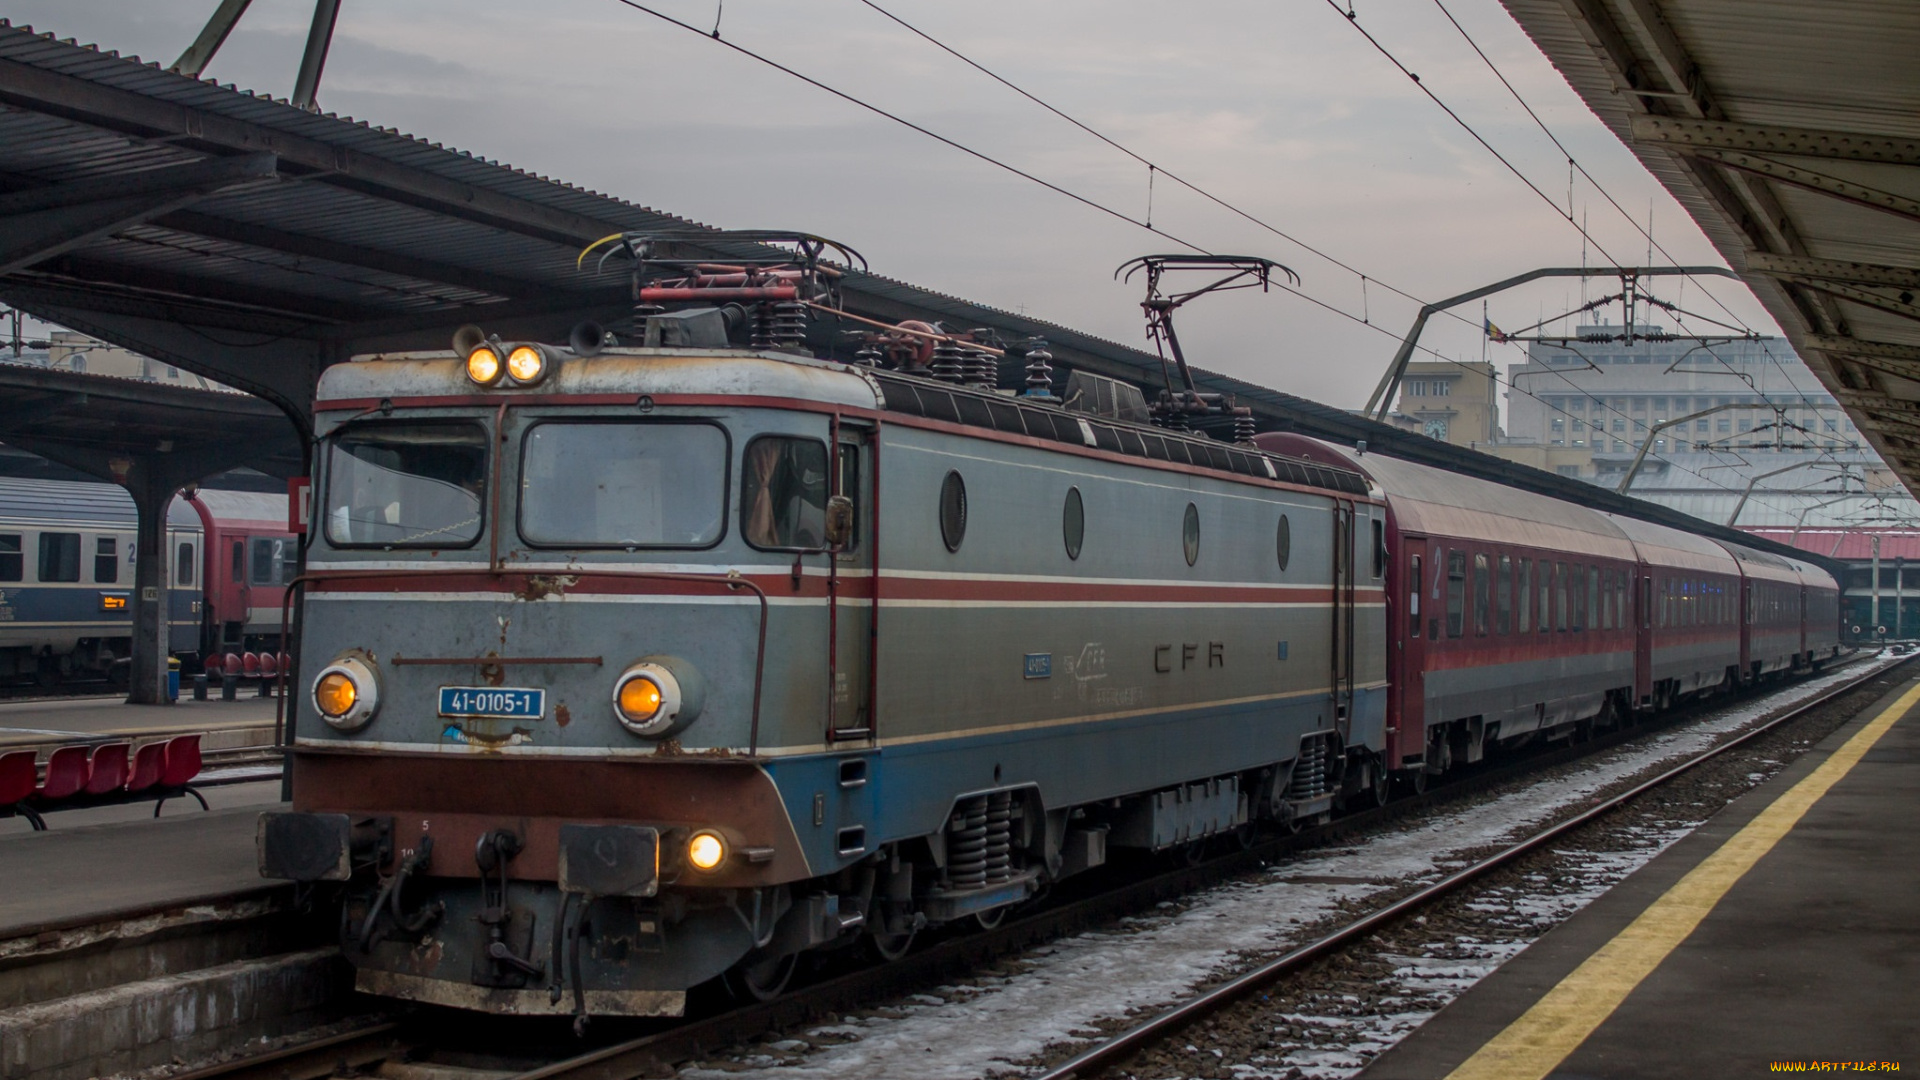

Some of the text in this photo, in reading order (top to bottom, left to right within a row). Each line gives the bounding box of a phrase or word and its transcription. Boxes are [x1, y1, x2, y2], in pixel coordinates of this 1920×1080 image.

[128, 543, 136, 563] 2
[273, 540, 283, 559] 2
[1432, 545, 1441, 600] 2
[1154, 640, 1224, 673] CFR
[451, 692, 530, 713] 41-0105-1
[422, 820, 429, 831] 5
